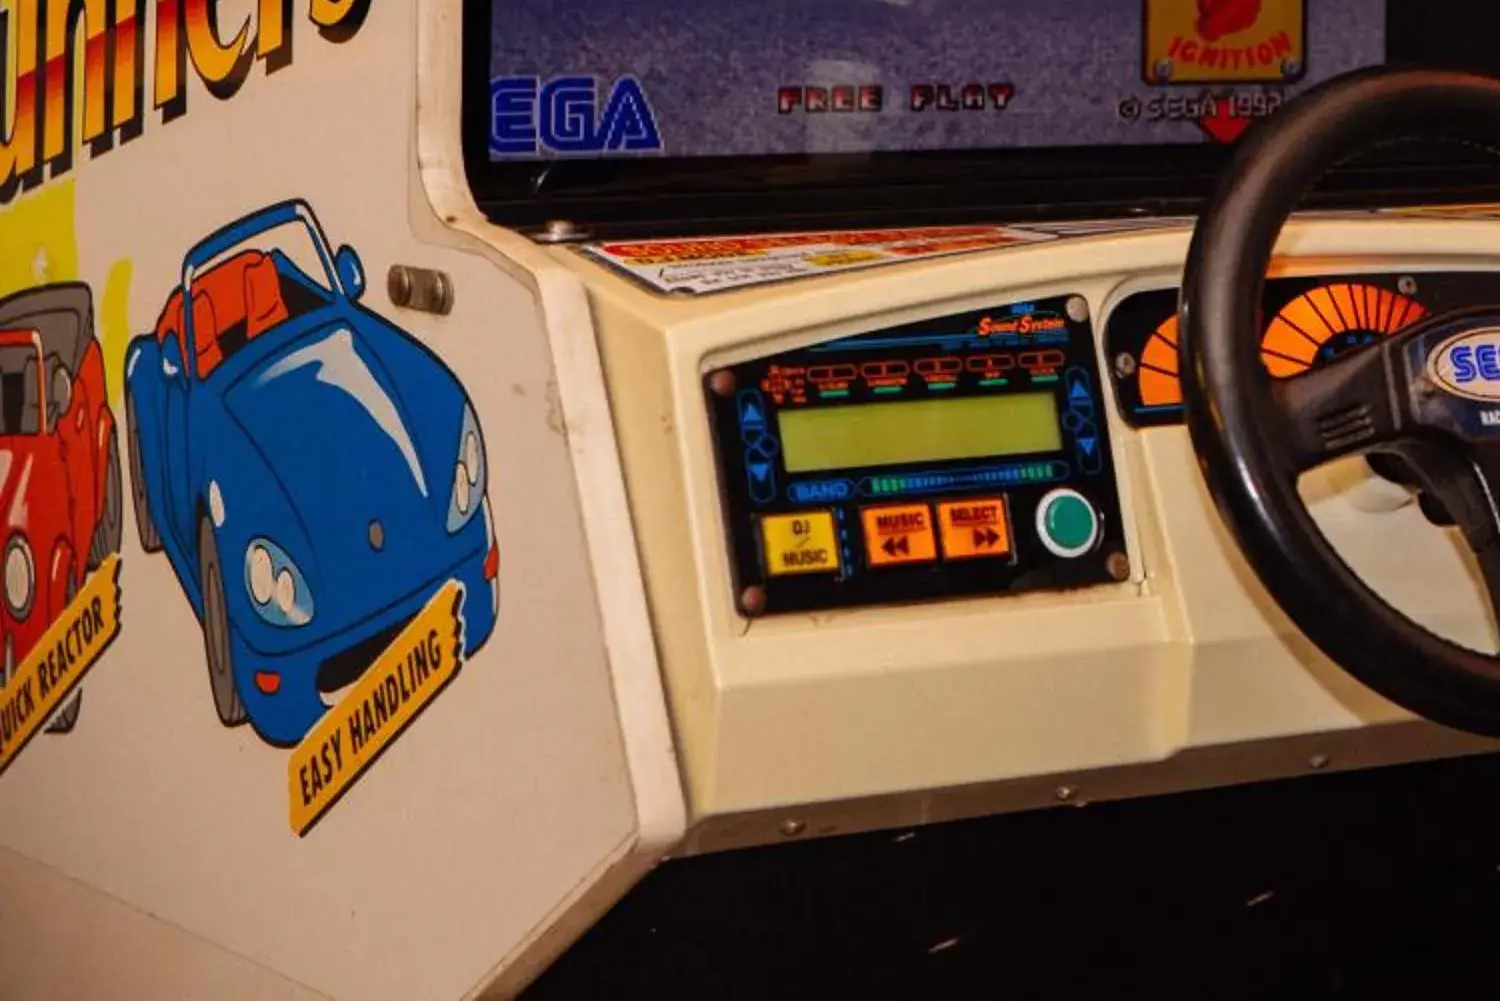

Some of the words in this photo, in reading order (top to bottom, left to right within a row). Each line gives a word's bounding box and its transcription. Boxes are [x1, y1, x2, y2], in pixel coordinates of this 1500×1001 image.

[1167, 30, 1292, 70] IGNITION
[777, 85, 883, 115] FREE
[910, 83, 1016, 113] PLAY
[791, 520, 811, 536] DJ
[876, 512, 924, 529] MUSIC
[950, 505, 998, 522] SELECT
[782, 549, 828, 566] MUSIC
[0, 674, 36, 757] UICK
[37, 595, 106, 698] REACTOR
[298, 734, 344, 807] EASY
[348, 625, 442, 762] HANDLING
